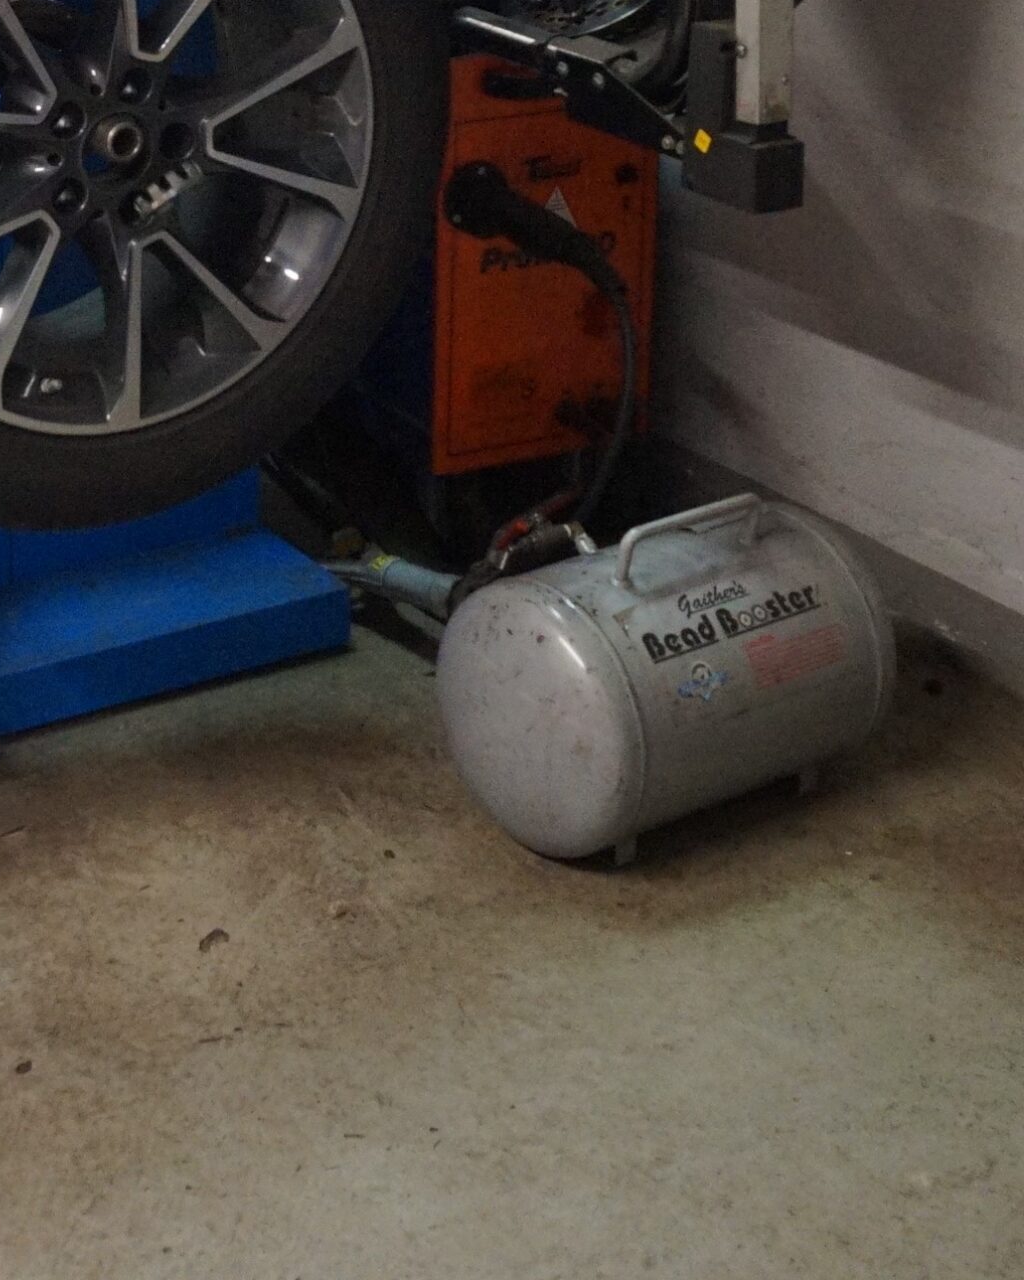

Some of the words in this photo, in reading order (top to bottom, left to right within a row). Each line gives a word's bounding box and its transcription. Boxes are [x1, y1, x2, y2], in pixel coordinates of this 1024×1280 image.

[642, 614, 717, 662] Bead
[716, 585, 816, 636] Booster
[679, 580, 747, 617] Gaither's
